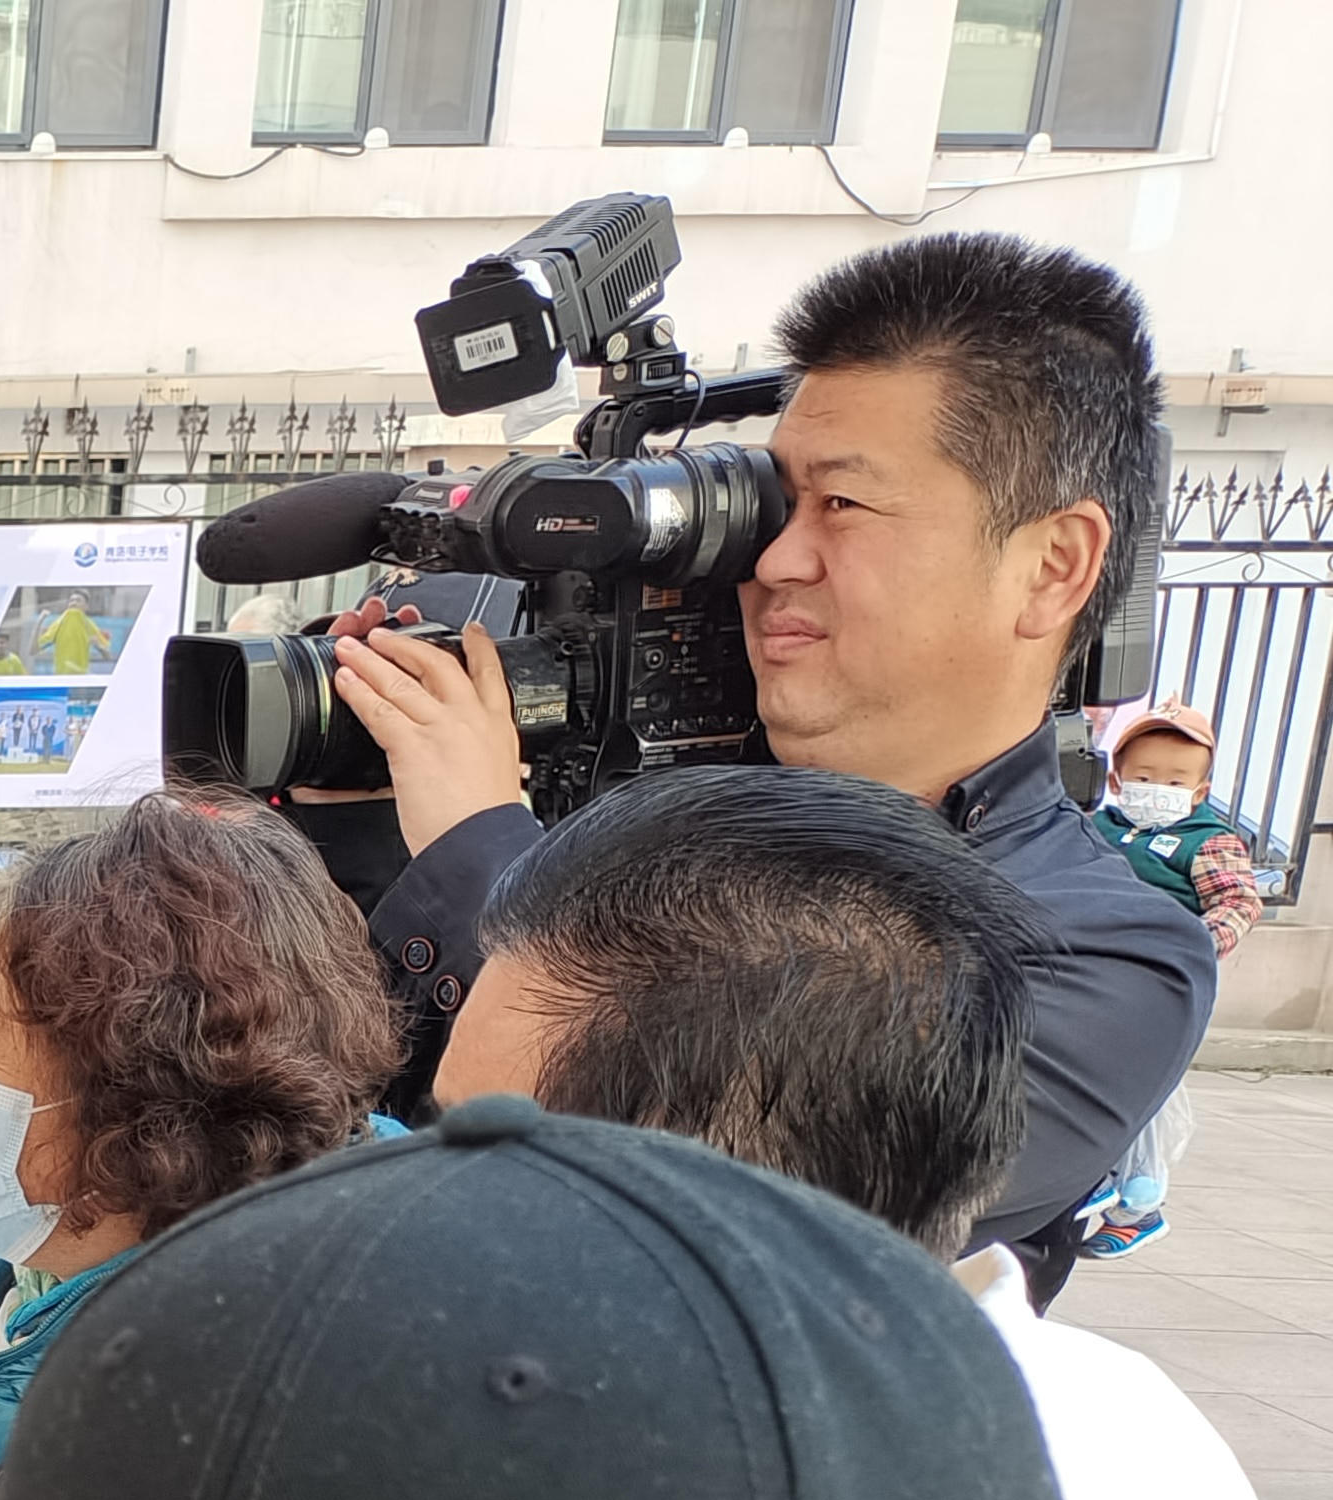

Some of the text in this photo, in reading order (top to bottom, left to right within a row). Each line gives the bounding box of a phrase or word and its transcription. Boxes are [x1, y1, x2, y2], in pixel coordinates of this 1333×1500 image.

[628, 281, 658, 308] SWIT
[535, 517, 563, 532] HD
[521, 702, 566, 717] FUJINON
